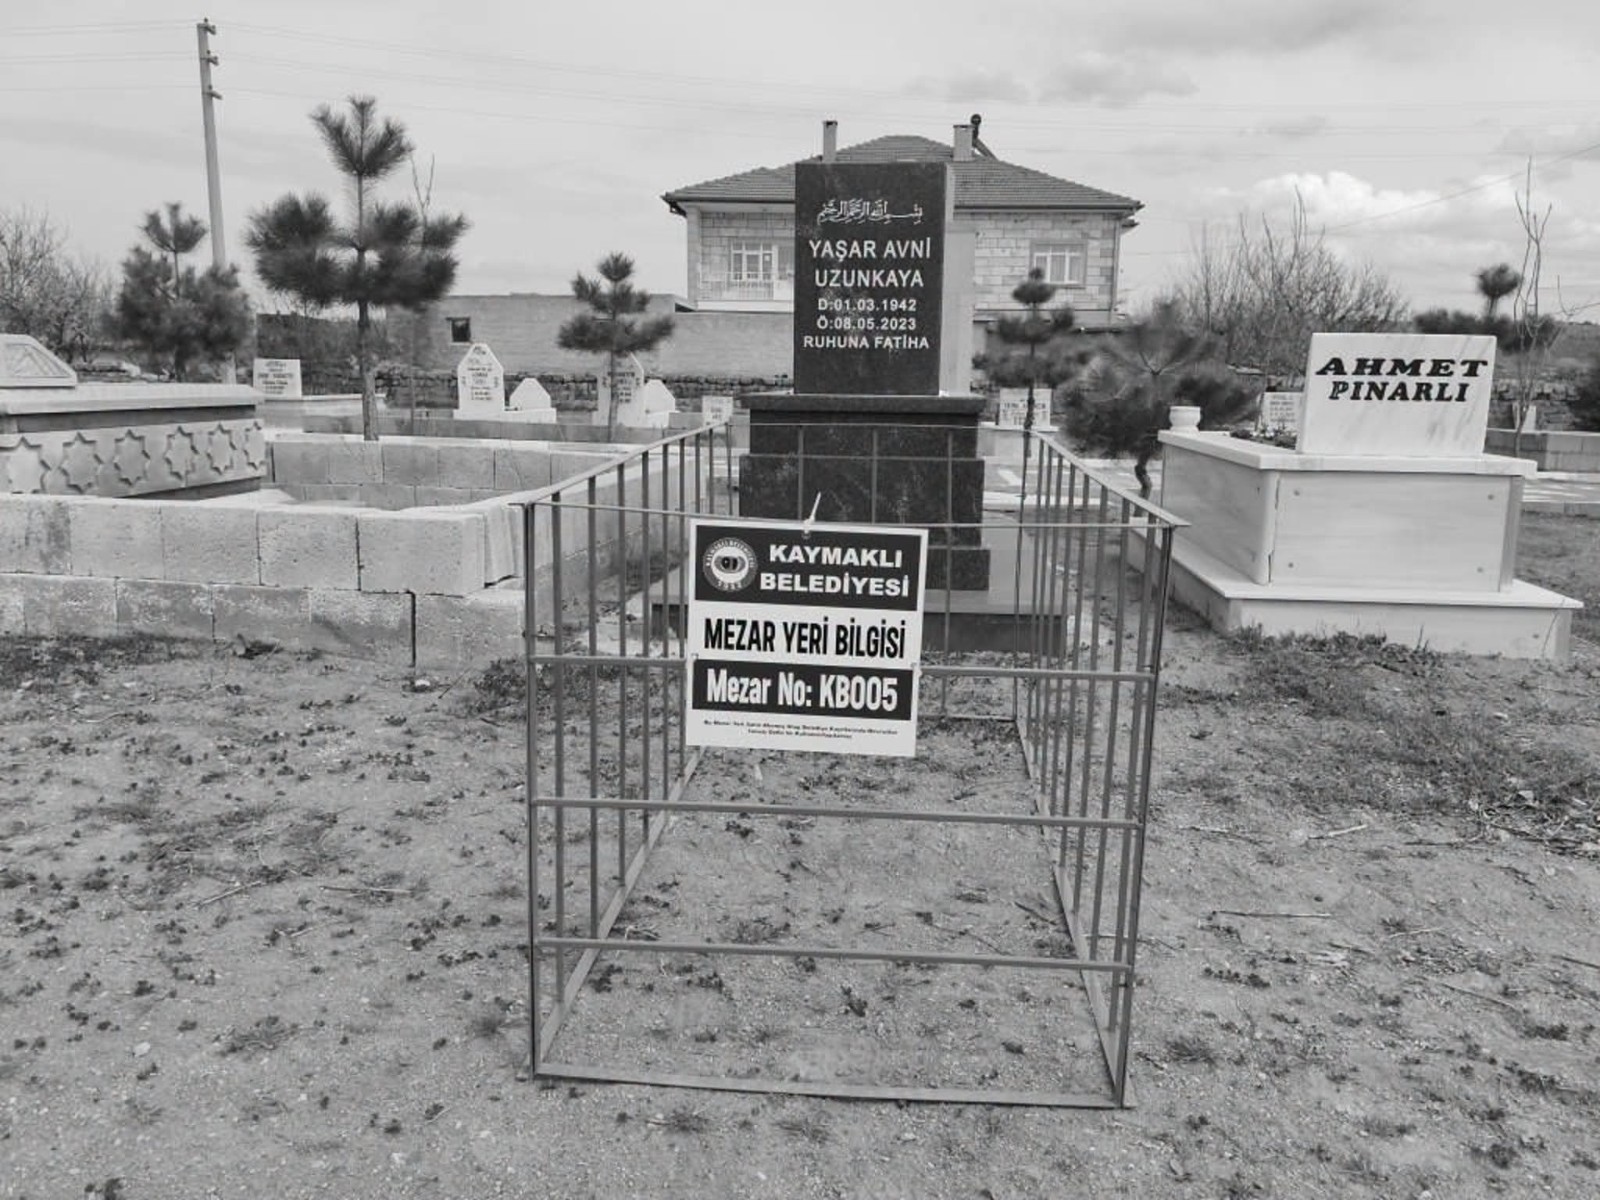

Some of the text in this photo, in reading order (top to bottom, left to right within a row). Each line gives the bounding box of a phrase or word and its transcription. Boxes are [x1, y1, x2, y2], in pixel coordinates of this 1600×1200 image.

[808, 237, 932, 263] YAŞAR AVNİ
[814, 269, 925, 288] UZUNKAYA
[803, 334, 930, 350] RUHUNA FATİHA
[1314, 357, 1488, 378] AHMET
[1328, 381, 1470, 402] PINARLI
[769, 543, 903, 569] KAYMAKLI
[760, 572, 909, 598] BELEDİYESİ
[703, 616, 906, 659] MEZAR YERİ BİLGİSİ
[706, 668, 898, 712] Mezar No: KB005
